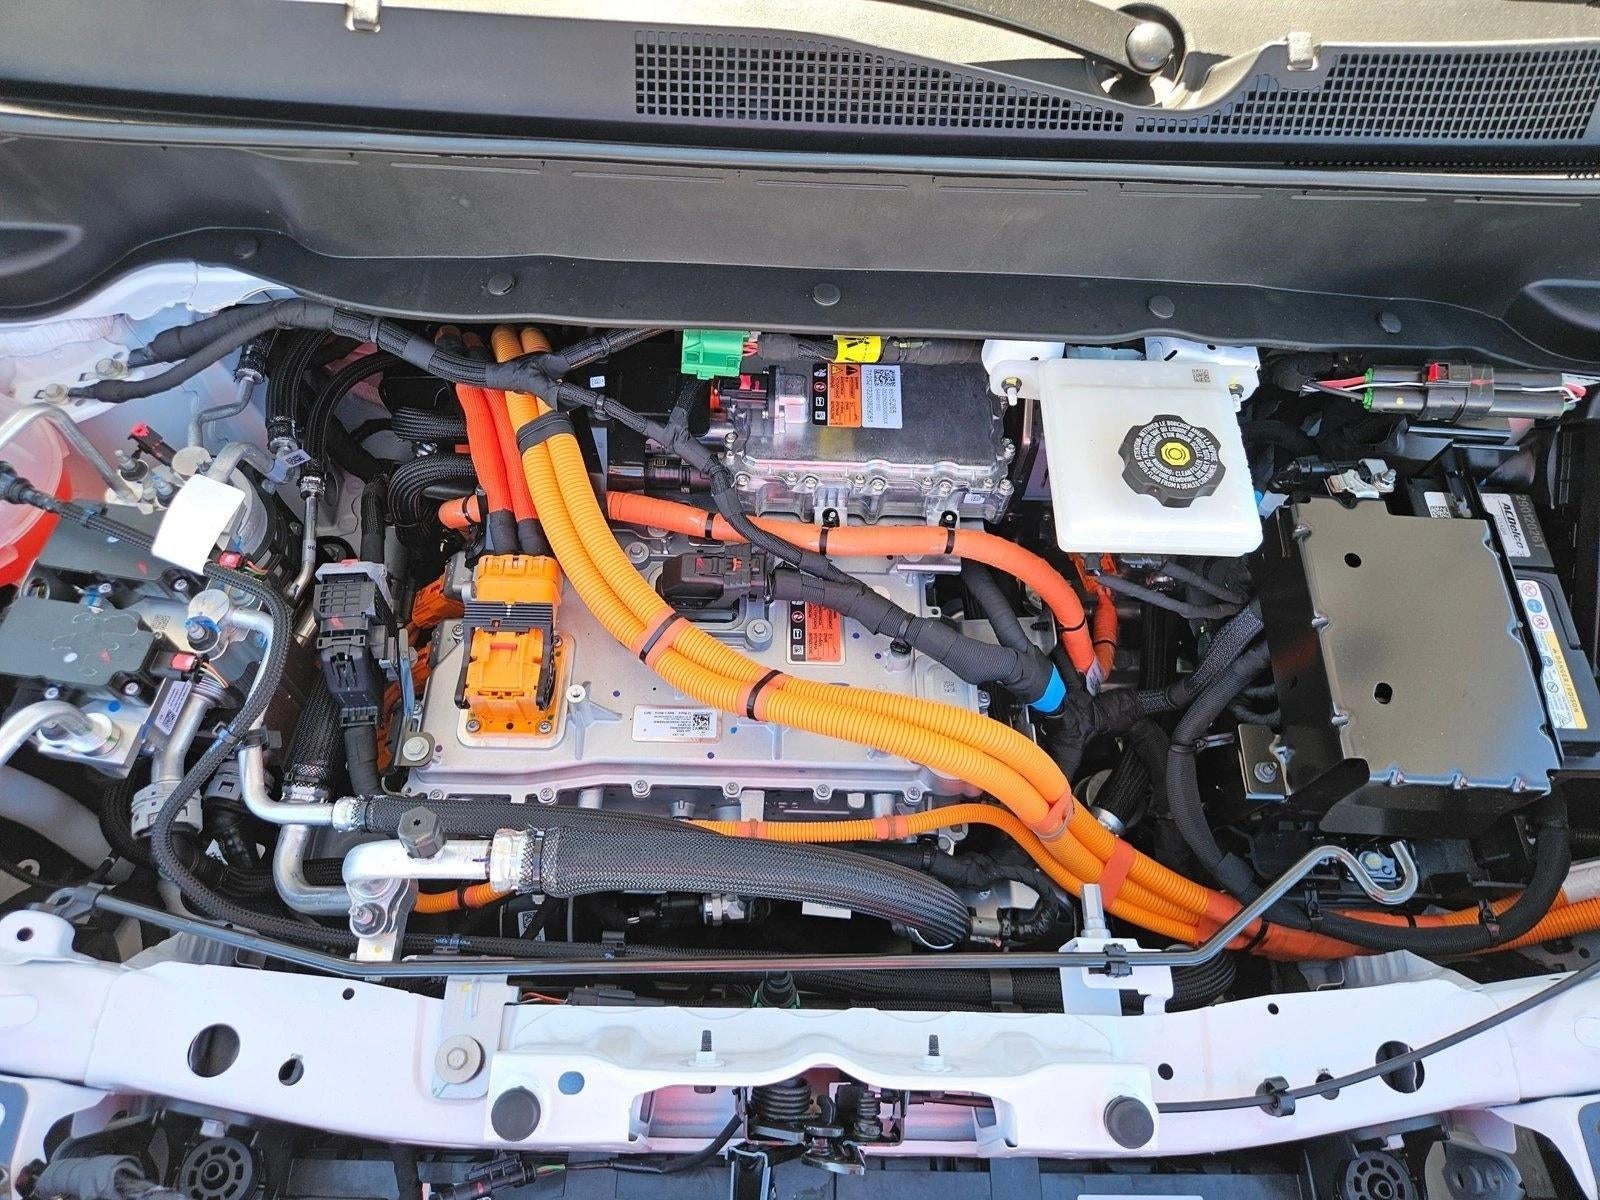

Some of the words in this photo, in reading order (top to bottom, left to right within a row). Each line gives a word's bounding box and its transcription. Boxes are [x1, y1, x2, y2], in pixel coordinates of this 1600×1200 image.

[1144, 459, 1153, 467] CAP
[1150, 466, 1169, 480] BEFORE
[1191, 460, 1202, 472] FILLER
[1146, 471, 1161, 483] FLUID
[1160, 480, 1176, 488] FROM
[1502, 502, 1524, 549] ACDelco
[1556, 656, 1568, 682] DANGER
[1567, 688, 1580, 713] POISON
